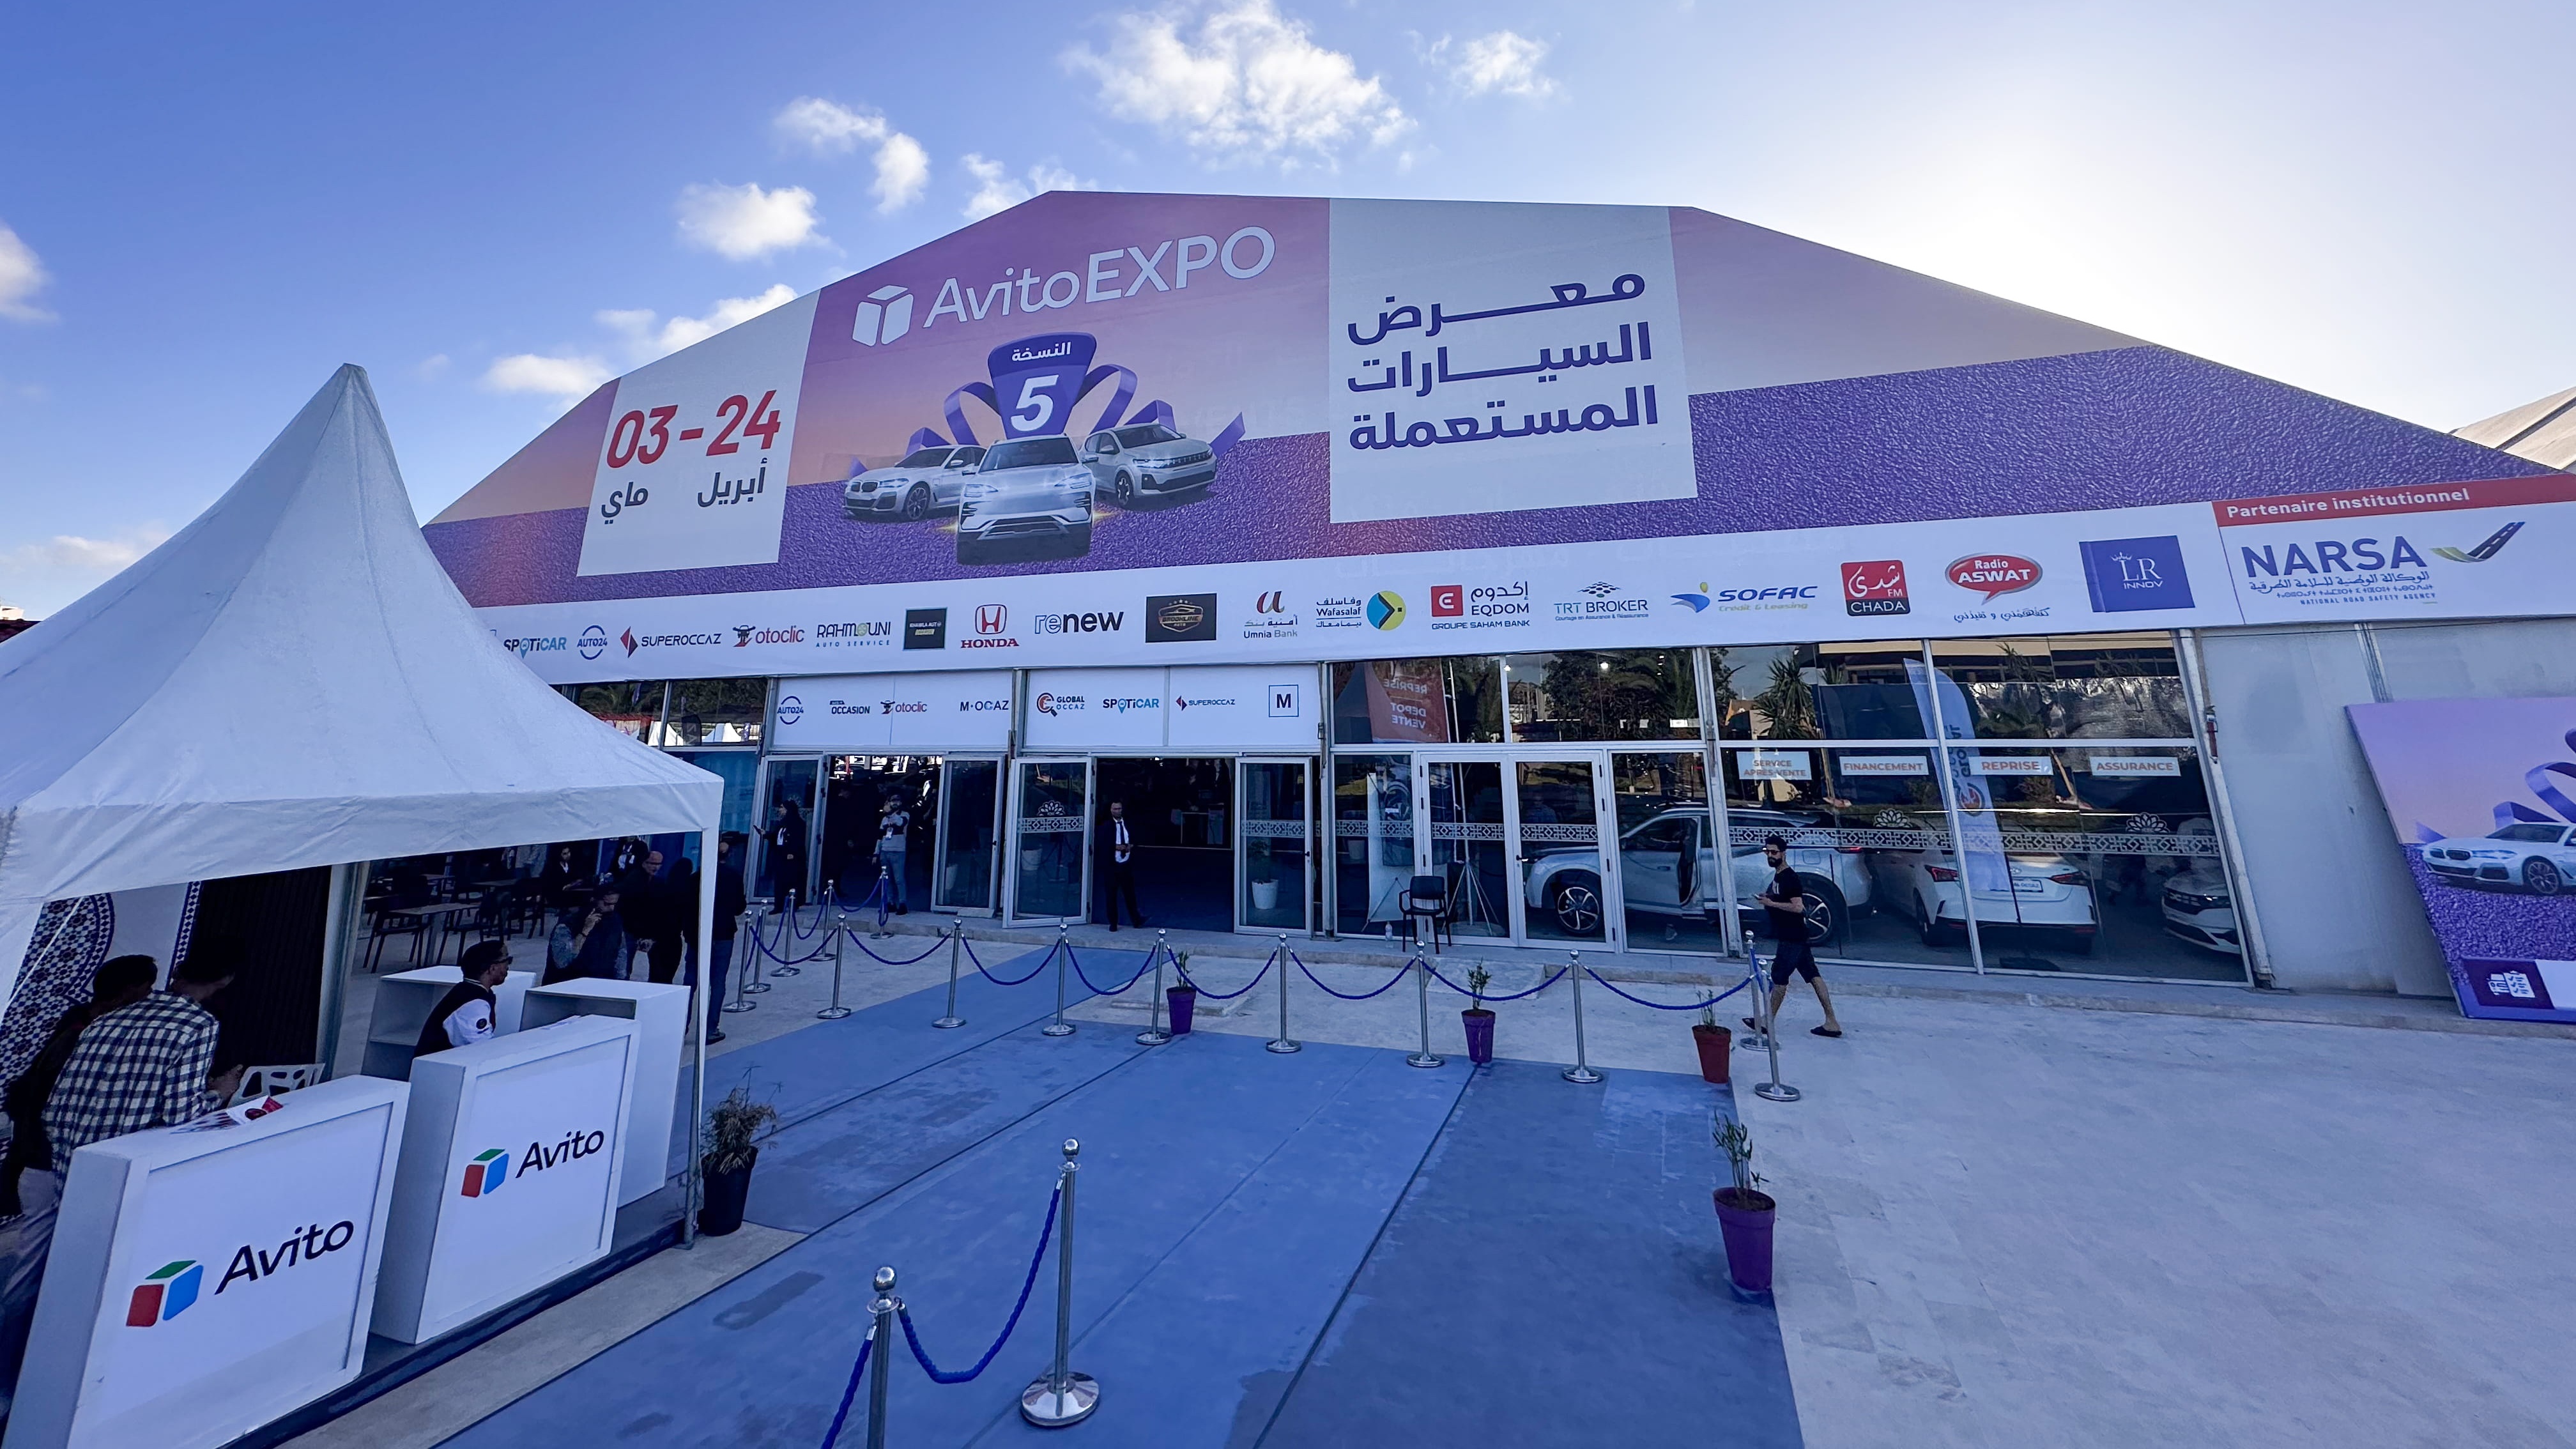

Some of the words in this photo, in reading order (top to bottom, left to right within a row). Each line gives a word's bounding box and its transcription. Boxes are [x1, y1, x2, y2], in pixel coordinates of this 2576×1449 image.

[922, 226, 1276, 328] AvitoEXPO
[1347, 273, 1645, 345] معرض
[1011, 341, 1071, 361] النسخة
[1347, 321, 1652, 397] السيارات
[1011, 374, 1060, 432] 5
[1349, 385, 1658, 449] المستعملة
[698, 457, 768, 507] أبريل
[601, 482, 648, 524] ماي
[2227, 499, 2327, 518] Partenaire
[2332, 487, 2470, 510] institutionnel
[2241, 535, 2427, 578] NARSA
[1974, 559, 2009, 569] Radio
[2119, 558, 2162, 581] LR
[1958, 569, 2031, 584] ASWAT
[2296, 577, 2333, 588] للسلامة
[2336, 574, 2378, 586] الوطنية
[2382, 571, 2430, 583] الوكالة
[1471, 581, 1528, 602] إكدوم
[2123, 580, 2163, 590] INNOV
[2250, 579, 2291, 594] الطرقية
[1717, 586, 1818, 602] SOFAC
[1888, 588, 1903, 597] FM
[1316, 597, 1361, 606] وفاسلف
[1554, 602, 1581, 614] TRT
[1586, 599, 1648, 613] BROKER
[1765, 602, 1808, 611] Leasing
[1850, 601, 1906, 613] CHADA
[1316, 608, 1361, 617] Wafasalaf
[1471, 604, 1529, 617] EQDOM
[1035, 611, 1124, 634] renew
[1268, 614, 1298, 628] أمنية
[756, 625, 804, 644] otoclic
[817, 622, 891, 638] RAHMOUNI
[1274, 629, 1298, 638] Bank
[577, 638, 608, 648] AUTO24
[641, 632, 721, 646] SUPEROCCAZ
[961, 638, 1019, 648] HONDA
[895, 701, 927, 712] otoclic
[1276, 693, 1291, 709] M
[777, 706, 804, 714] AUTO24
[831, 706, 870, 714] OCCASION
[1844, 763, 1923, 772] FINANCEMENT
[1982, 761, 2040, 770] REPRISE
[2097, 762, 2174, 772] ASSURANCE
[515, 1130, 604, 1179] Avito
[214, 1220, 354, 1295] Avito
